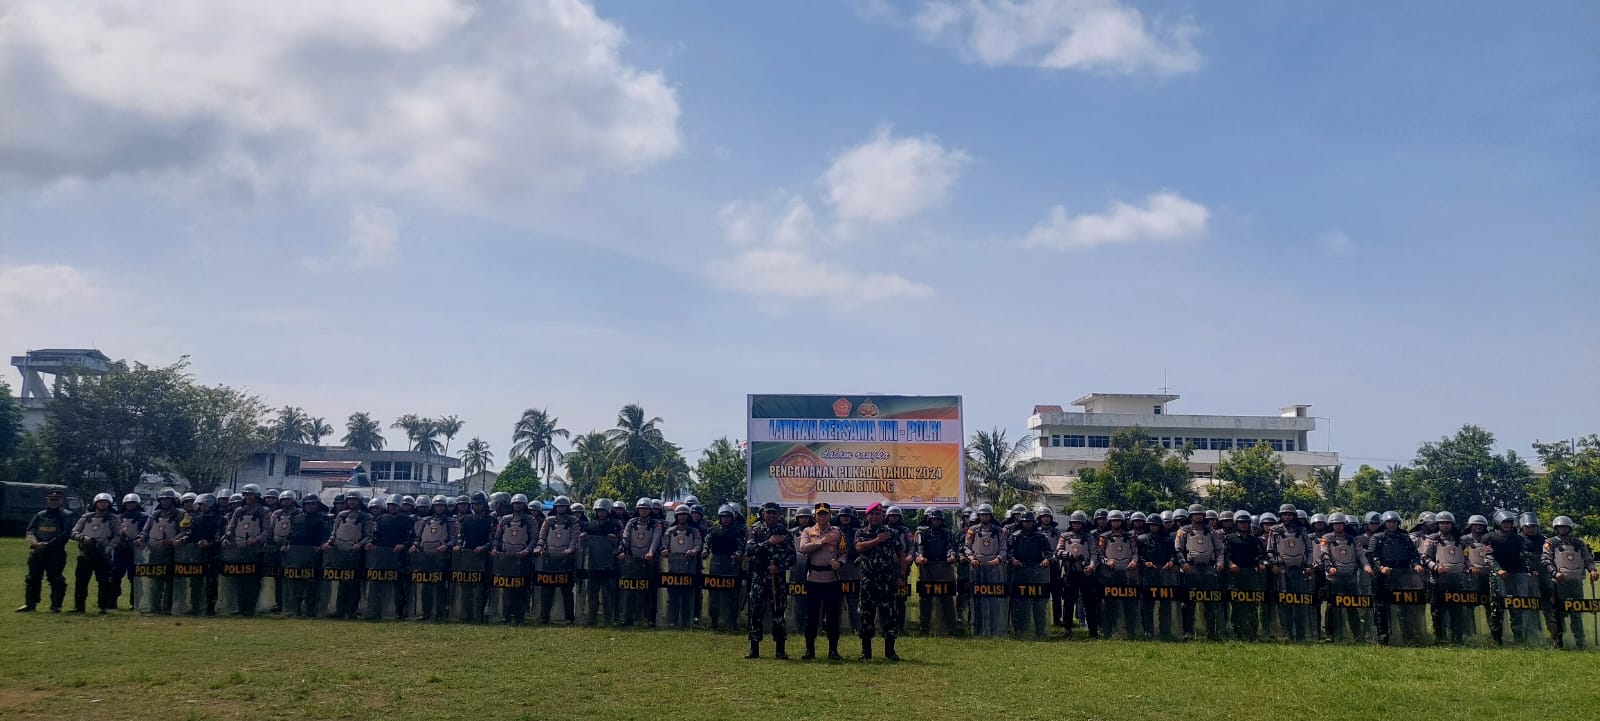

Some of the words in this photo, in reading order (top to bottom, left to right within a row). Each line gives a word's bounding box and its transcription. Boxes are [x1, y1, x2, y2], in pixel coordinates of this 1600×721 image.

[769, 419, 817, 440] LATIHAN
[818, 420, 877, 441] BERSAMA
[878, 420, 898, 441] TNI
[906, 420, 942, 442] POLRI
[821, 447, 852, 460] dalam
[855, 451, 890, 463] rangka
[769, 465, 835, 478] PENGAMANAN
[838, 466, 879, 479] PILKADA
[881, 466, 914, 479] TAHUN
[916, 466, 943, 479] 2024
[815, 479, 827, 492] DI
[829, 479, 855, 493] KOTA
[856, 479, 894, 493] BITUNG
[136, 565, 166, 576] POLISI
[174, 564, 203, 575] POLISI
[224, 564, 256, 574] POLISI
[284, 568, 314, 579] POLISI
[324, 568, 354, 580] POLISI
[367, 570, 398, 581] POLISI
[412, 572, 442, 583] POLISI
[452, 571, 481, 582] POLISI
[537, 574, 568, 584] POLISI
[662, 575, 692, 586] POLISI
[494, 576, 524, 588] POLISI
[618, 578, 649, 590] POLISI
[704, 577, 735, 588] POLISI
[841, 581, 856, 593] NI
[788, 584, 807, 595] POL
[925, 584, 948, 594] TNI
[974, 585, 1005, 595] POLISI
[1019, 586, 1042, 596] TNI
[1104, 586, 1137, 597] POLISI
[1150, 587, 1174, 598] TNI
[1189, 590, 1222, 601] POLISI
[1231, 591, 1265, 602] POLISI
[1279, 592, 1313, 605] POLISI
[1393, 591, 1418, 603] TNI
[1445, 592, 1478, 603] POLISI
[1336, 595, 1370, 608] POLISI
[1504, 597, 1540, 609] POLISI
